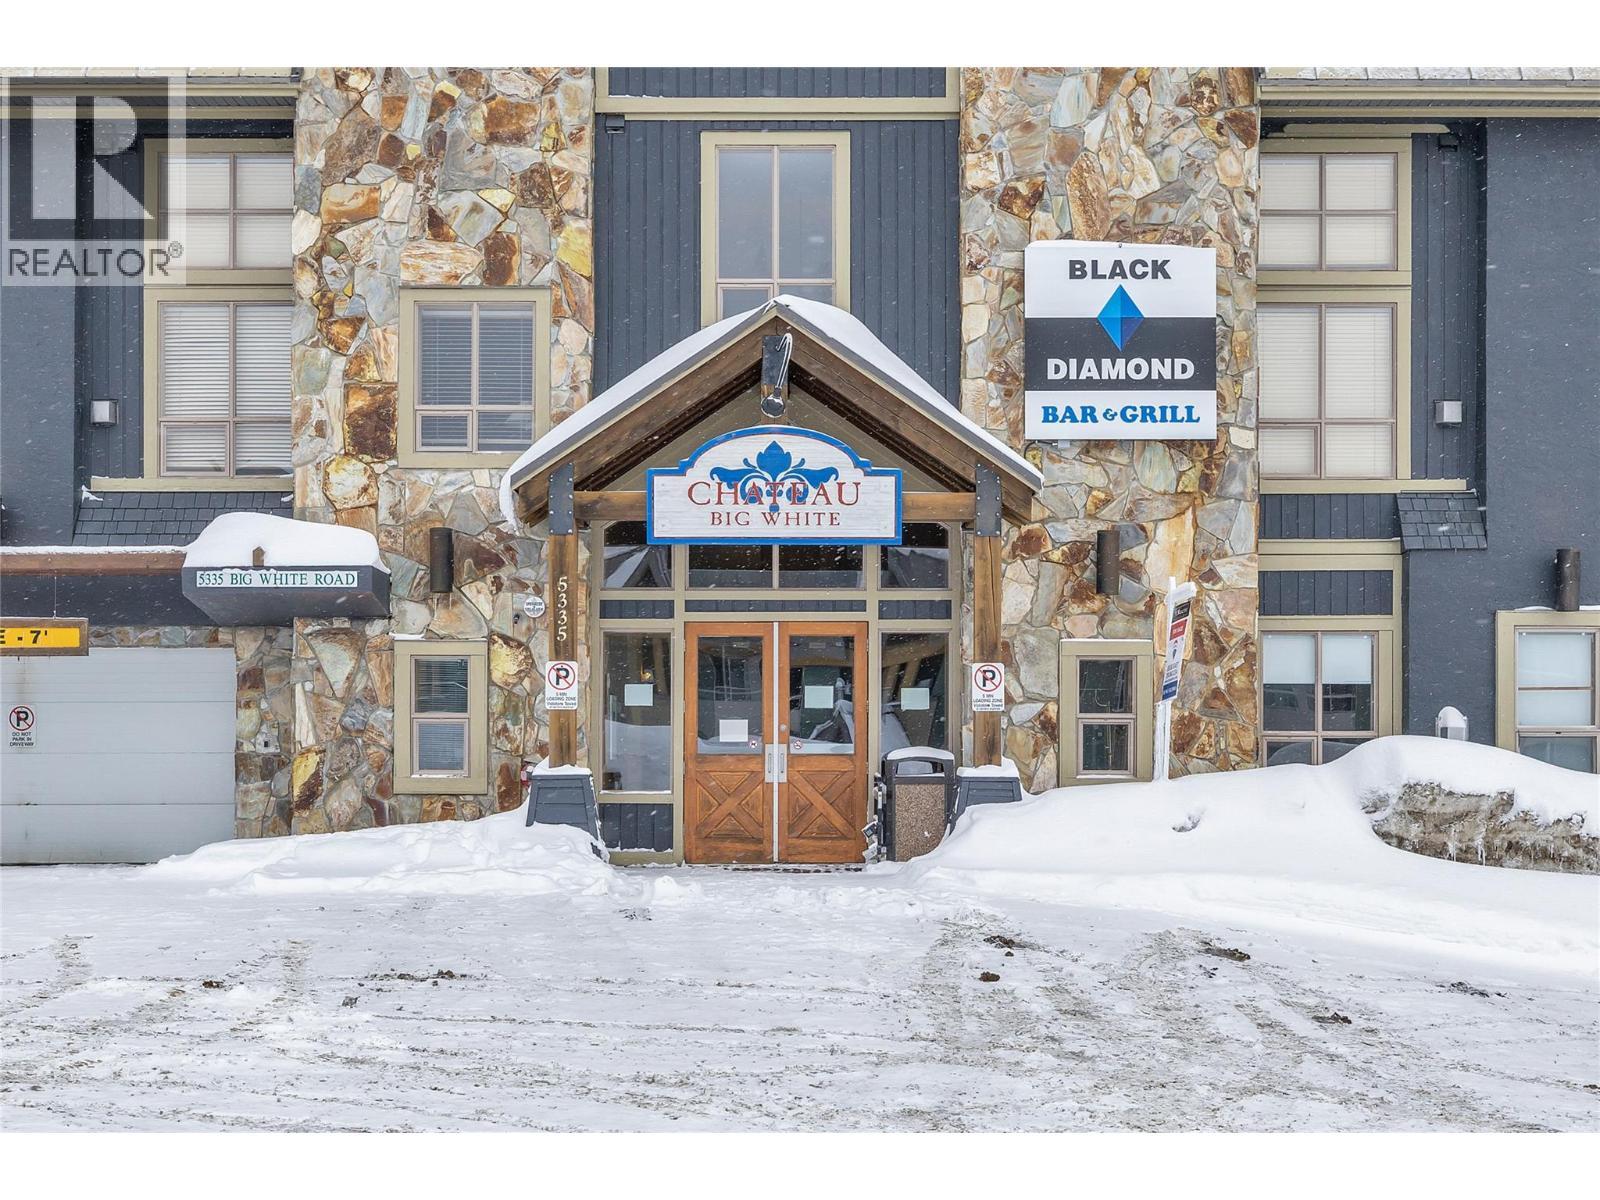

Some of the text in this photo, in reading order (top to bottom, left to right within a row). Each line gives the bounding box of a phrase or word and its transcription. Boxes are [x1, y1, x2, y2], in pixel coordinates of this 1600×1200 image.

[1068, 259, 1172, 280] BLACK
[1047, 357, 1195, 380] DIAMOND
[1041, 405, 1099, 423] BAR
[1119, 405, 1201, 424] GRILL
[687, 481, 862, 506] CHATEAU
[710, 511, 841, 526] BIG WHITE
[198, 573, 356, 586] 5335 BIG WHITE ROAD
[556, 576, 569, 642] 5335
